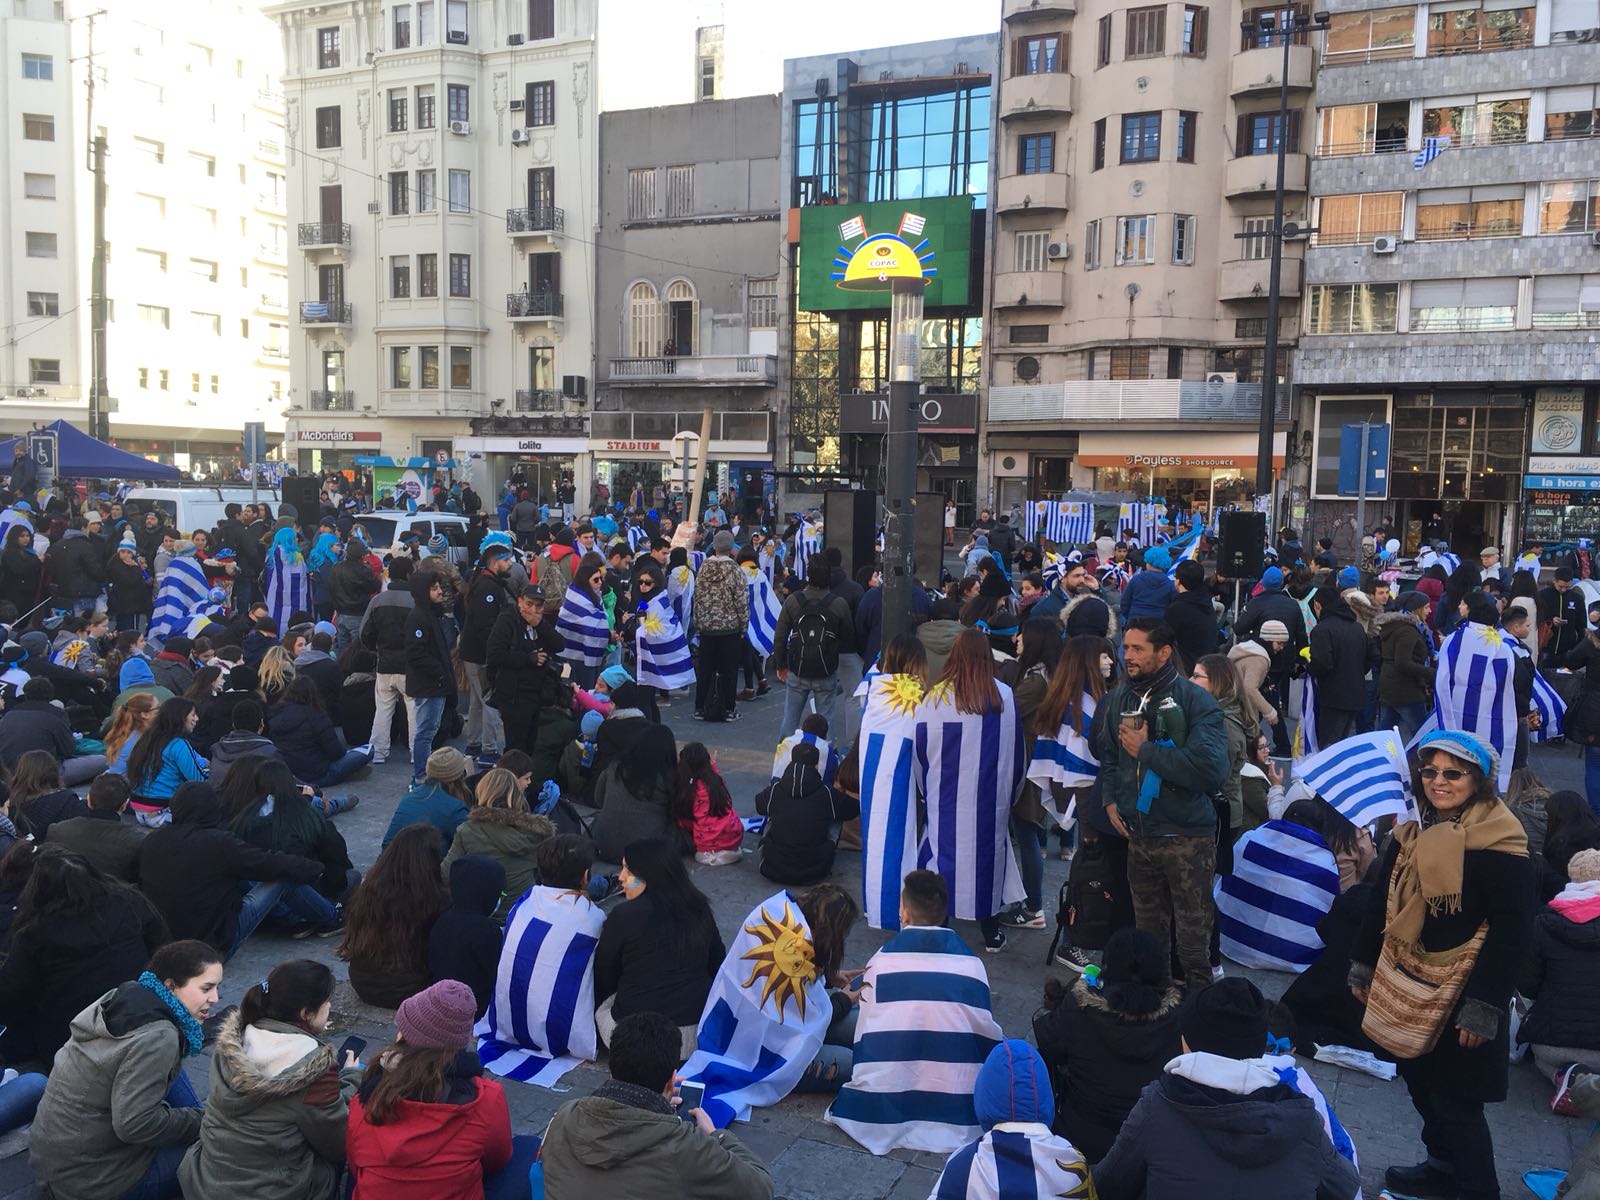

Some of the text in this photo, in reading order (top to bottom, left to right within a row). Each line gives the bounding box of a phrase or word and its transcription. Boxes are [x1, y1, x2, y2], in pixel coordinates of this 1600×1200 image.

[872, 399, 942, 421] IO
[518, 440, 542, 450] Lolita
[607, 441, 661, 450] STADIUM
[1134, 455, 1182, 467] Payless
[1542, 477, 1553, 487] la
[1557, 477, 1586, 487] hora
[1535, 491, 1571, 499] la hora
